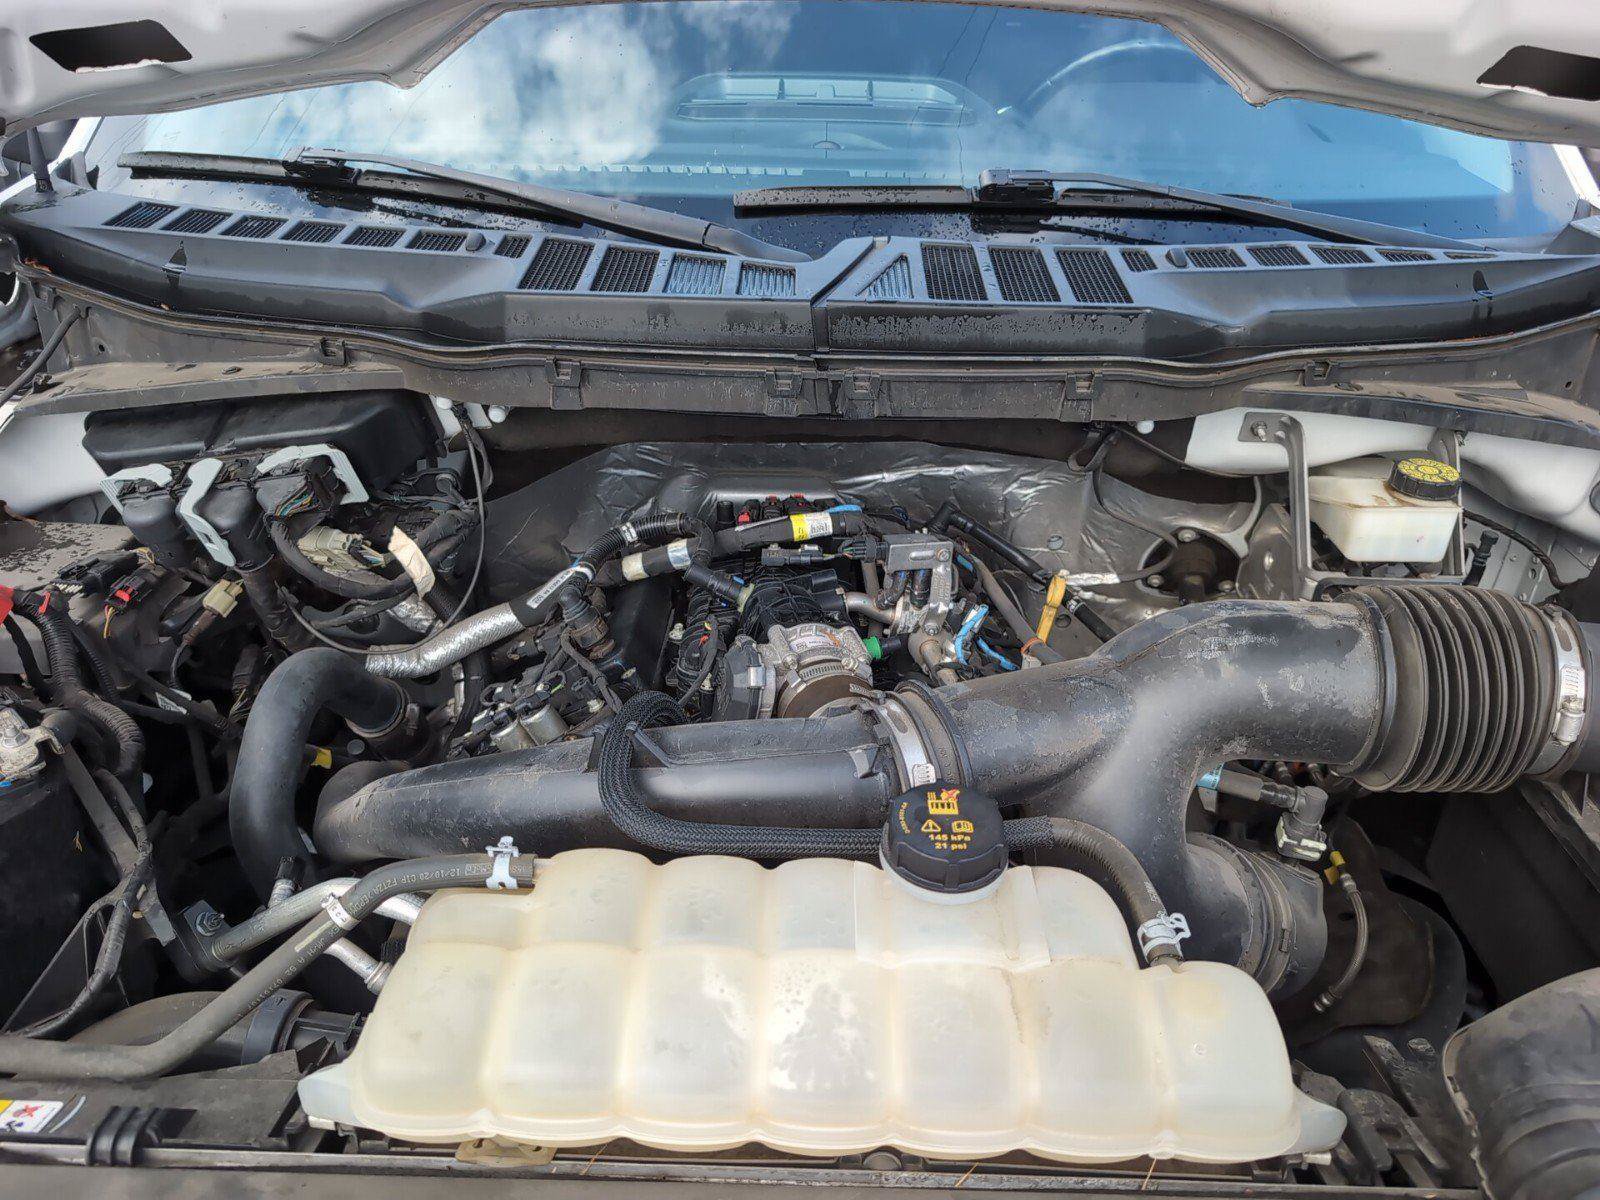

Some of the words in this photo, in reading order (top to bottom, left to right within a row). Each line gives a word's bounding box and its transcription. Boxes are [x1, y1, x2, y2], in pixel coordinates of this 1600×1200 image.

[929, 834, 948, 842] 145
[950, 834, 971, 842] kPa
[934, 842, 948, 850] 21
[950, 842, 967, 851] psi
